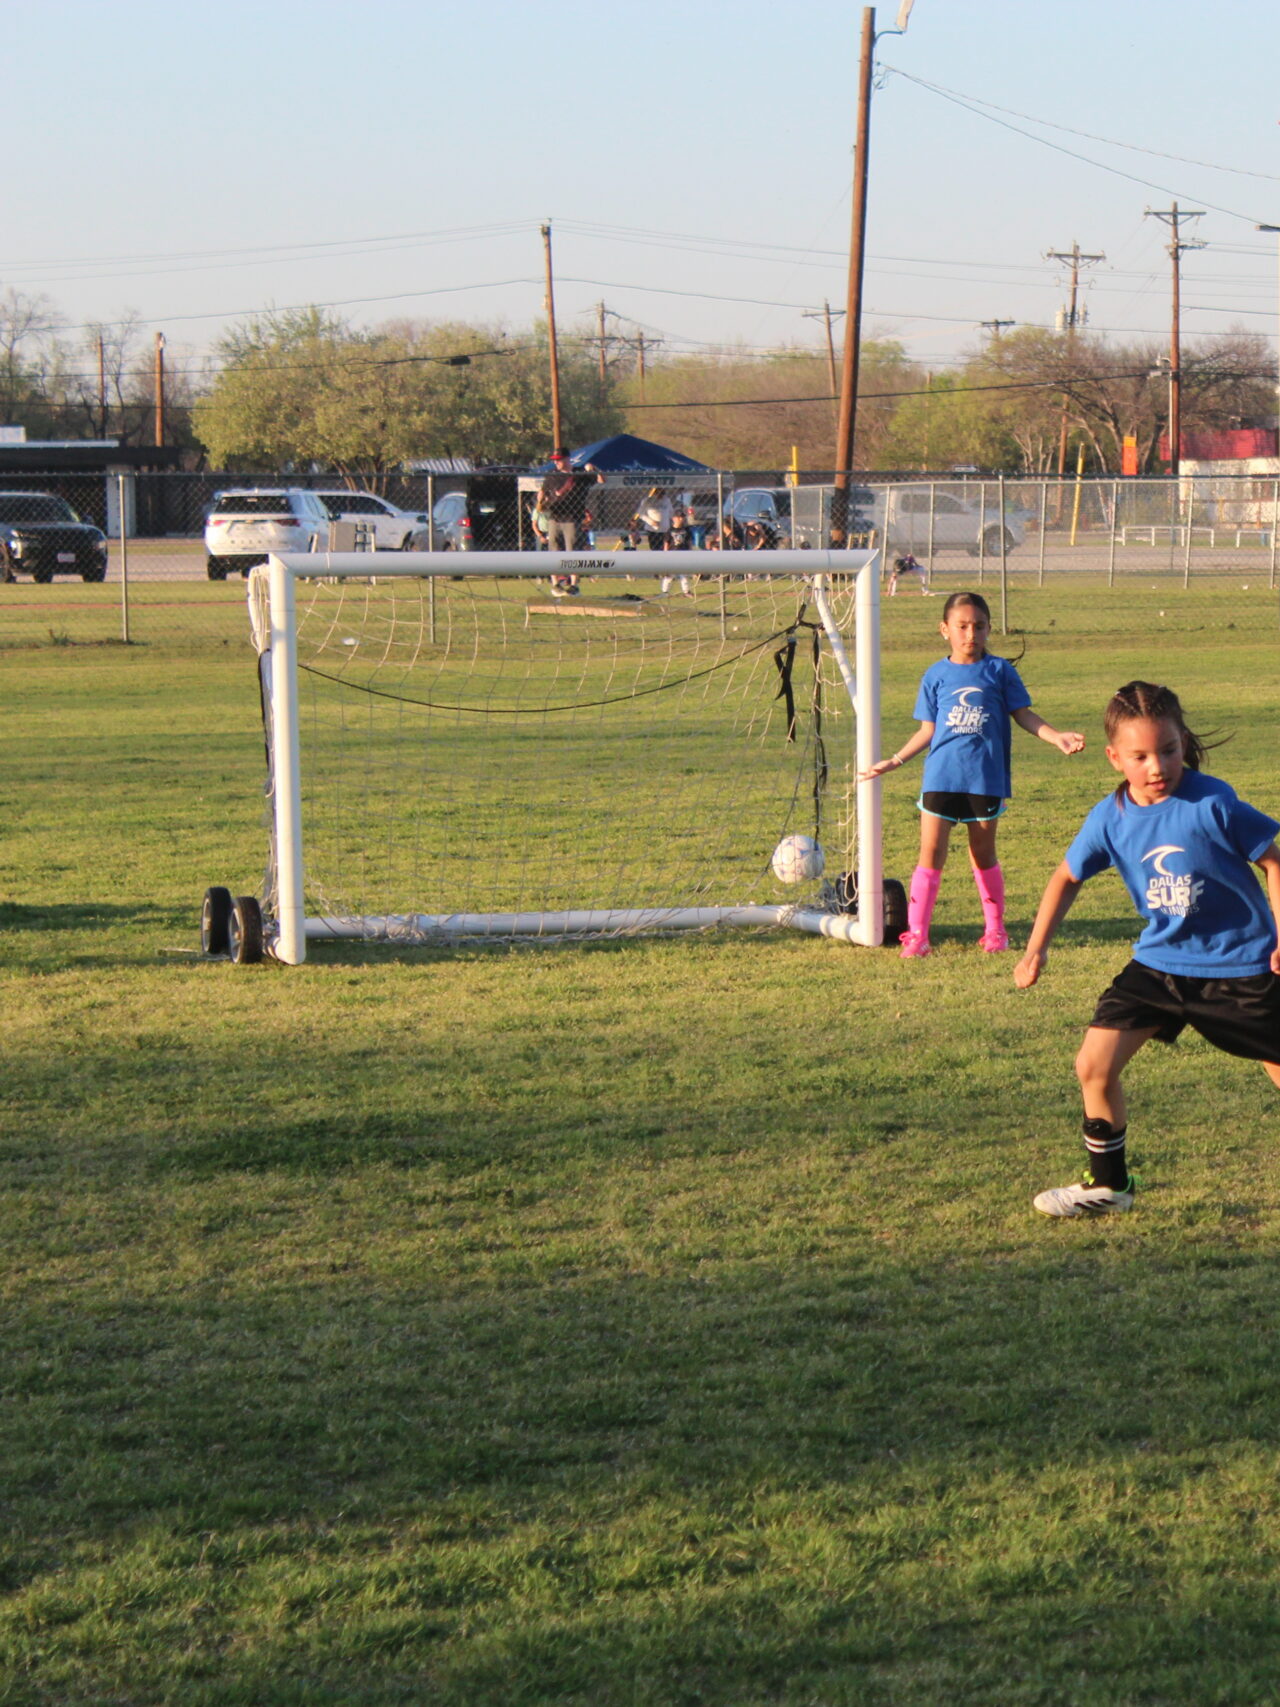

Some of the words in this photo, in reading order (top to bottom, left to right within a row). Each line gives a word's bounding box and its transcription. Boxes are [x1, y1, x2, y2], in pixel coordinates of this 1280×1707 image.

[953, 705, 983, 714] DALLAS
[945, 712, 990, 727] SURF
[1149, 874, 1191, 889] DALLAS
[1146, 880, 1205, 909] SURF
